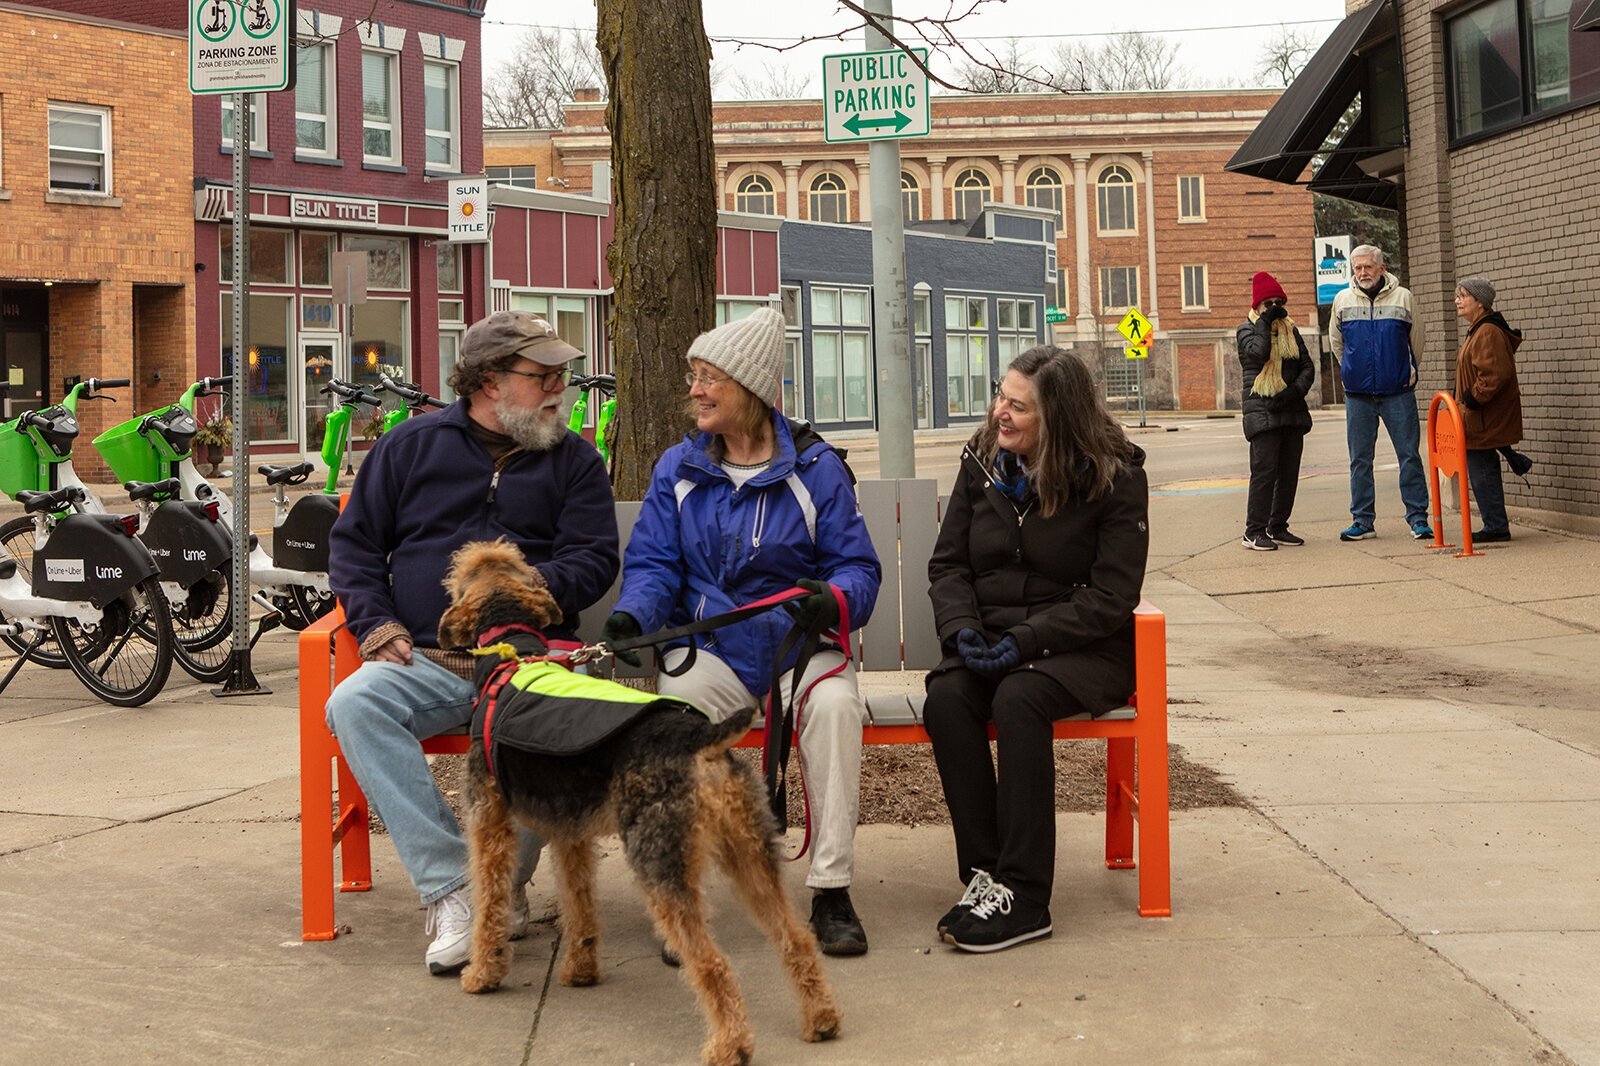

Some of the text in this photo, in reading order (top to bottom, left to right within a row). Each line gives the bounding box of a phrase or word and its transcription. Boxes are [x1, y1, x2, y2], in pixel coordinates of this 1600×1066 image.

[199, 45, 277, 60] PARKING ZONE
[197, 57, 279, 69] ZONA DE ESTACIONAMIENTO
[840, 53, 908, 82] PUBLIC
[834, 83, 916, 114] PARKING
[456, 186, 480, 195] SUN
[295, 202, 376, 221] SUN TITLE
[451, 223, 485, 233] TITLE
[3, 303, 20, 317] 1414
[260, 356, 281, 364] TITLE
[160, 548, 171, 557] Uber
[183, 549, 207, 561] Lime
[68, 566, 82, 576] Uber
[95, 566, 123, 579] Lime
